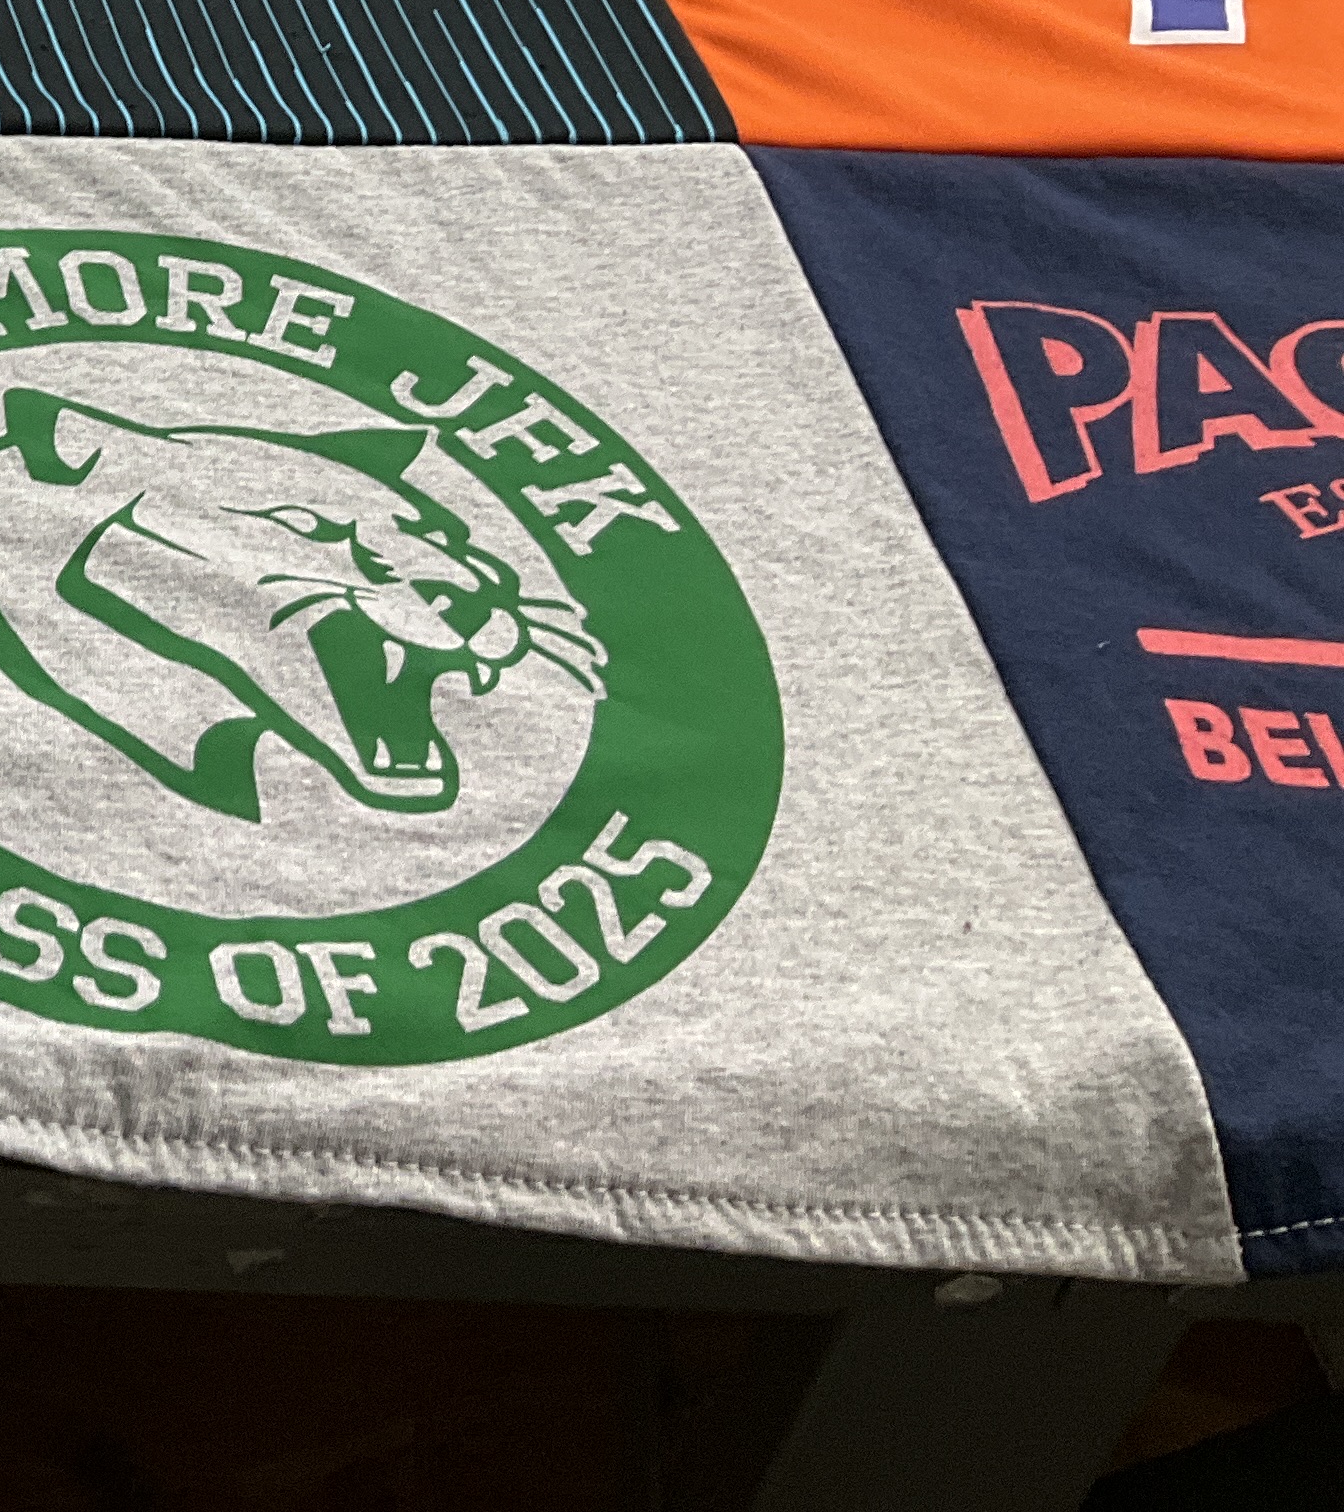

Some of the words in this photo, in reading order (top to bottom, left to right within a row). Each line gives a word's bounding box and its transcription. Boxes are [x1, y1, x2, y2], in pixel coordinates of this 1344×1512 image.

[390, 354, 682, 558] JFK
[208, 941, 379, 1035] OF
[409, 812, 712, 1034] 2025
